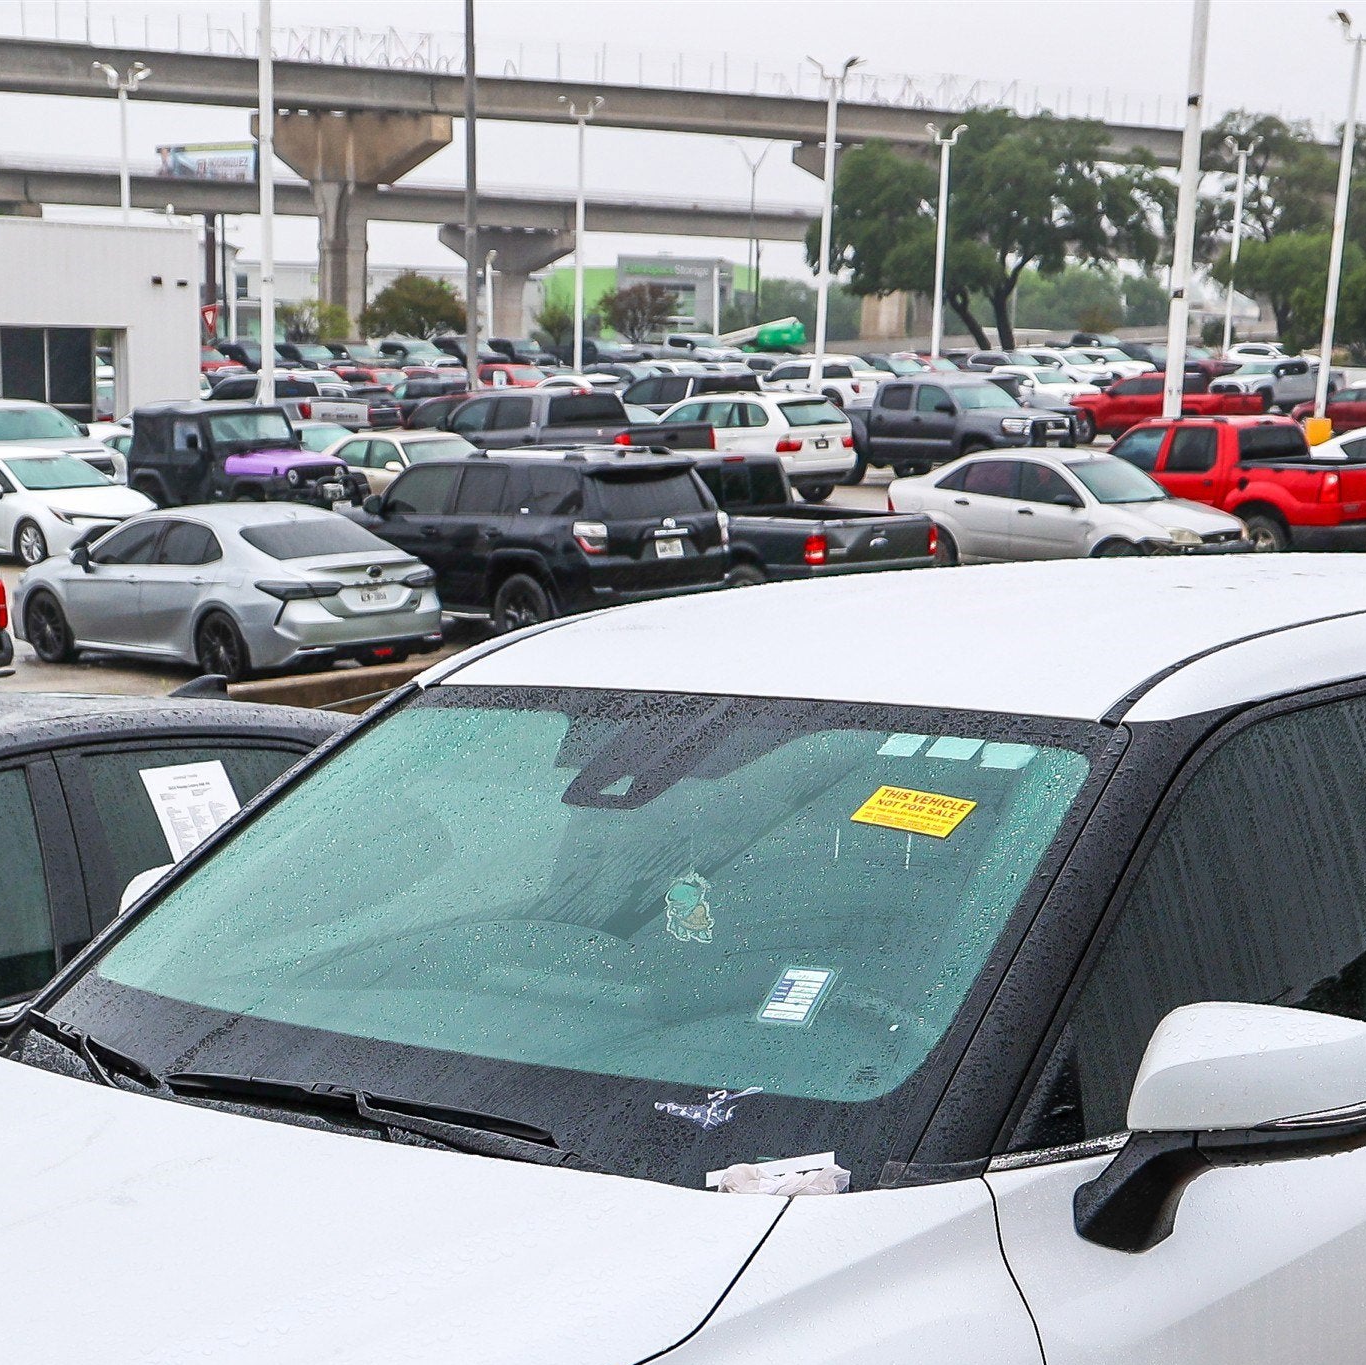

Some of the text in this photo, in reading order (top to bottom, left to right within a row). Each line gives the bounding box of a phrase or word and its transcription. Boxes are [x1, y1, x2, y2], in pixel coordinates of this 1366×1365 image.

[875, 798, 959, 819] NOT FOR SALE
[880, 788, 971, 812] THIS VEHICLE
